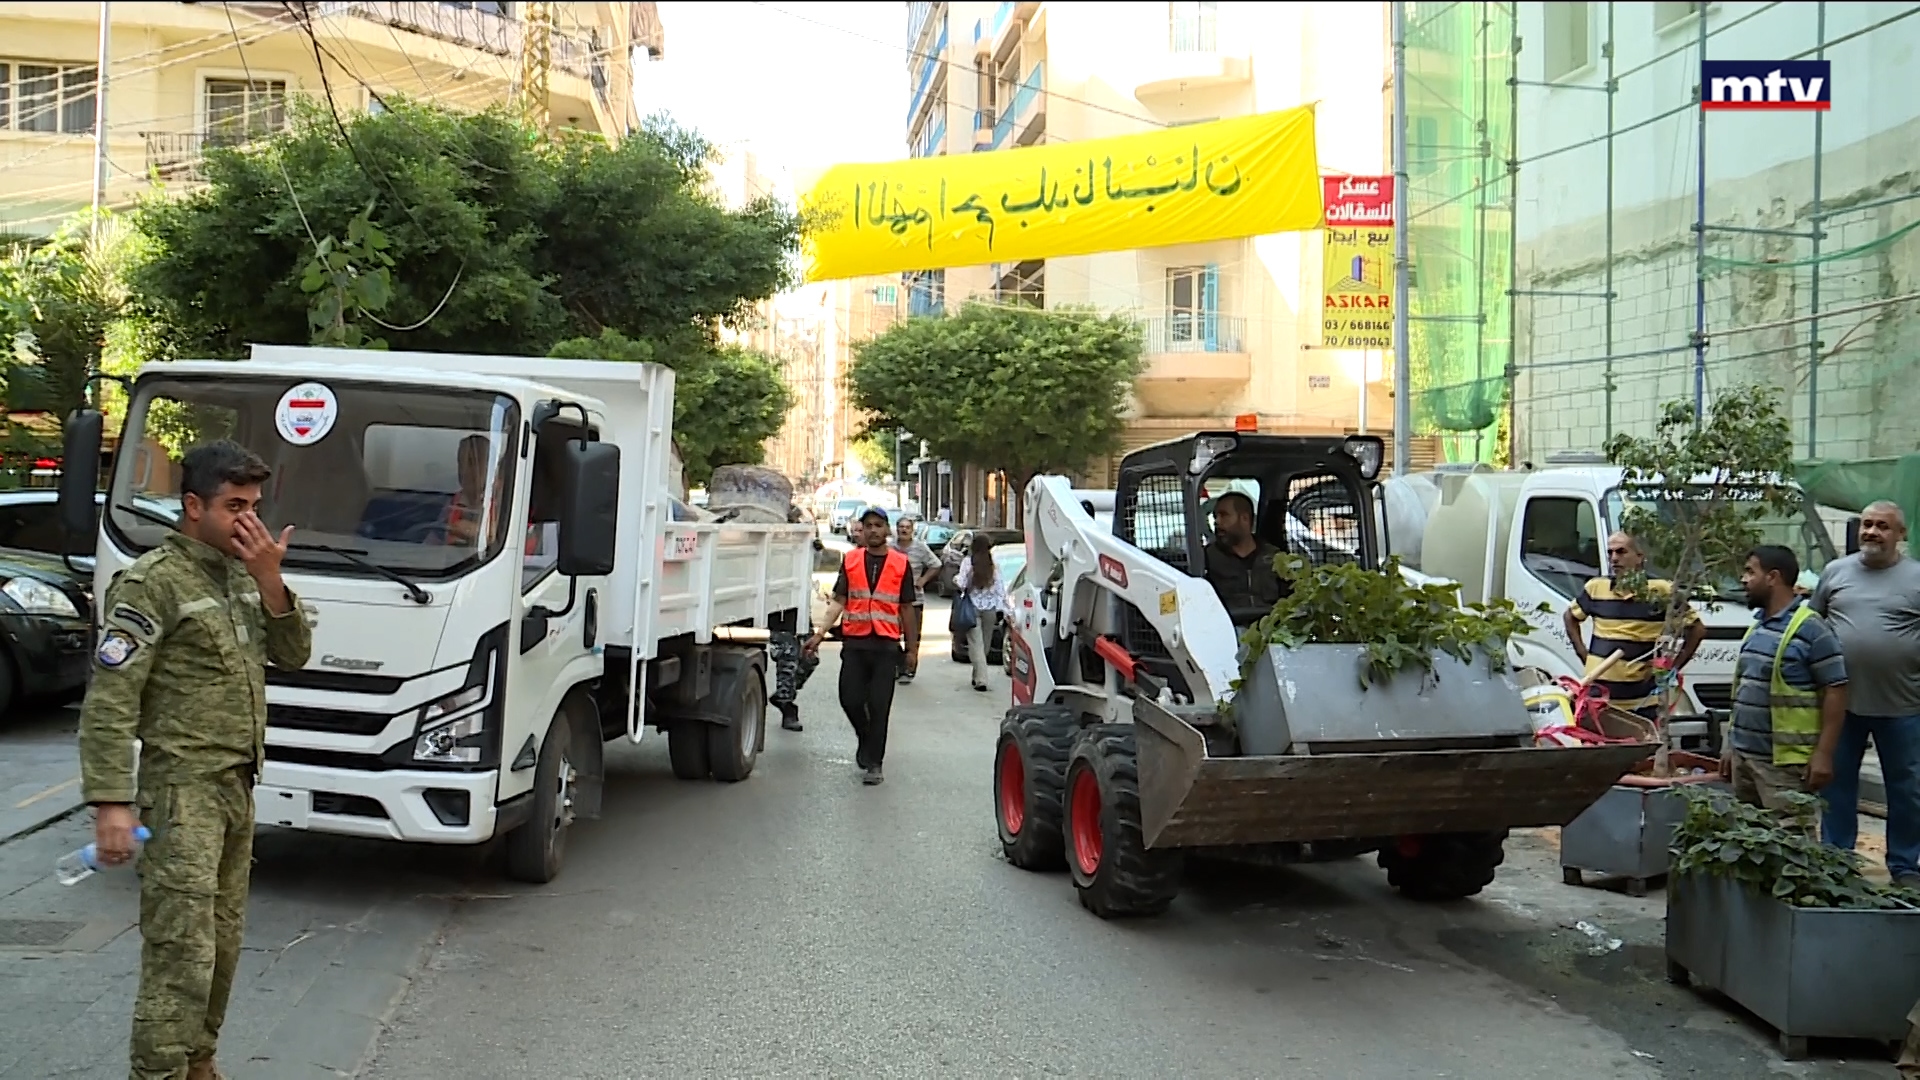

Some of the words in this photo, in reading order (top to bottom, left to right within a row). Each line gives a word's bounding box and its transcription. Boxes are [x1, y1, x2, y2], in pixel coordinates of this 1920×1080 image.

[1338, 175, 1380, 199] عسكر
[1326, 202, 1391, 221] للسقالات
[1367, 231, 1390, 247] بيع
[1325, 295, 1390, 308] ASKAR
